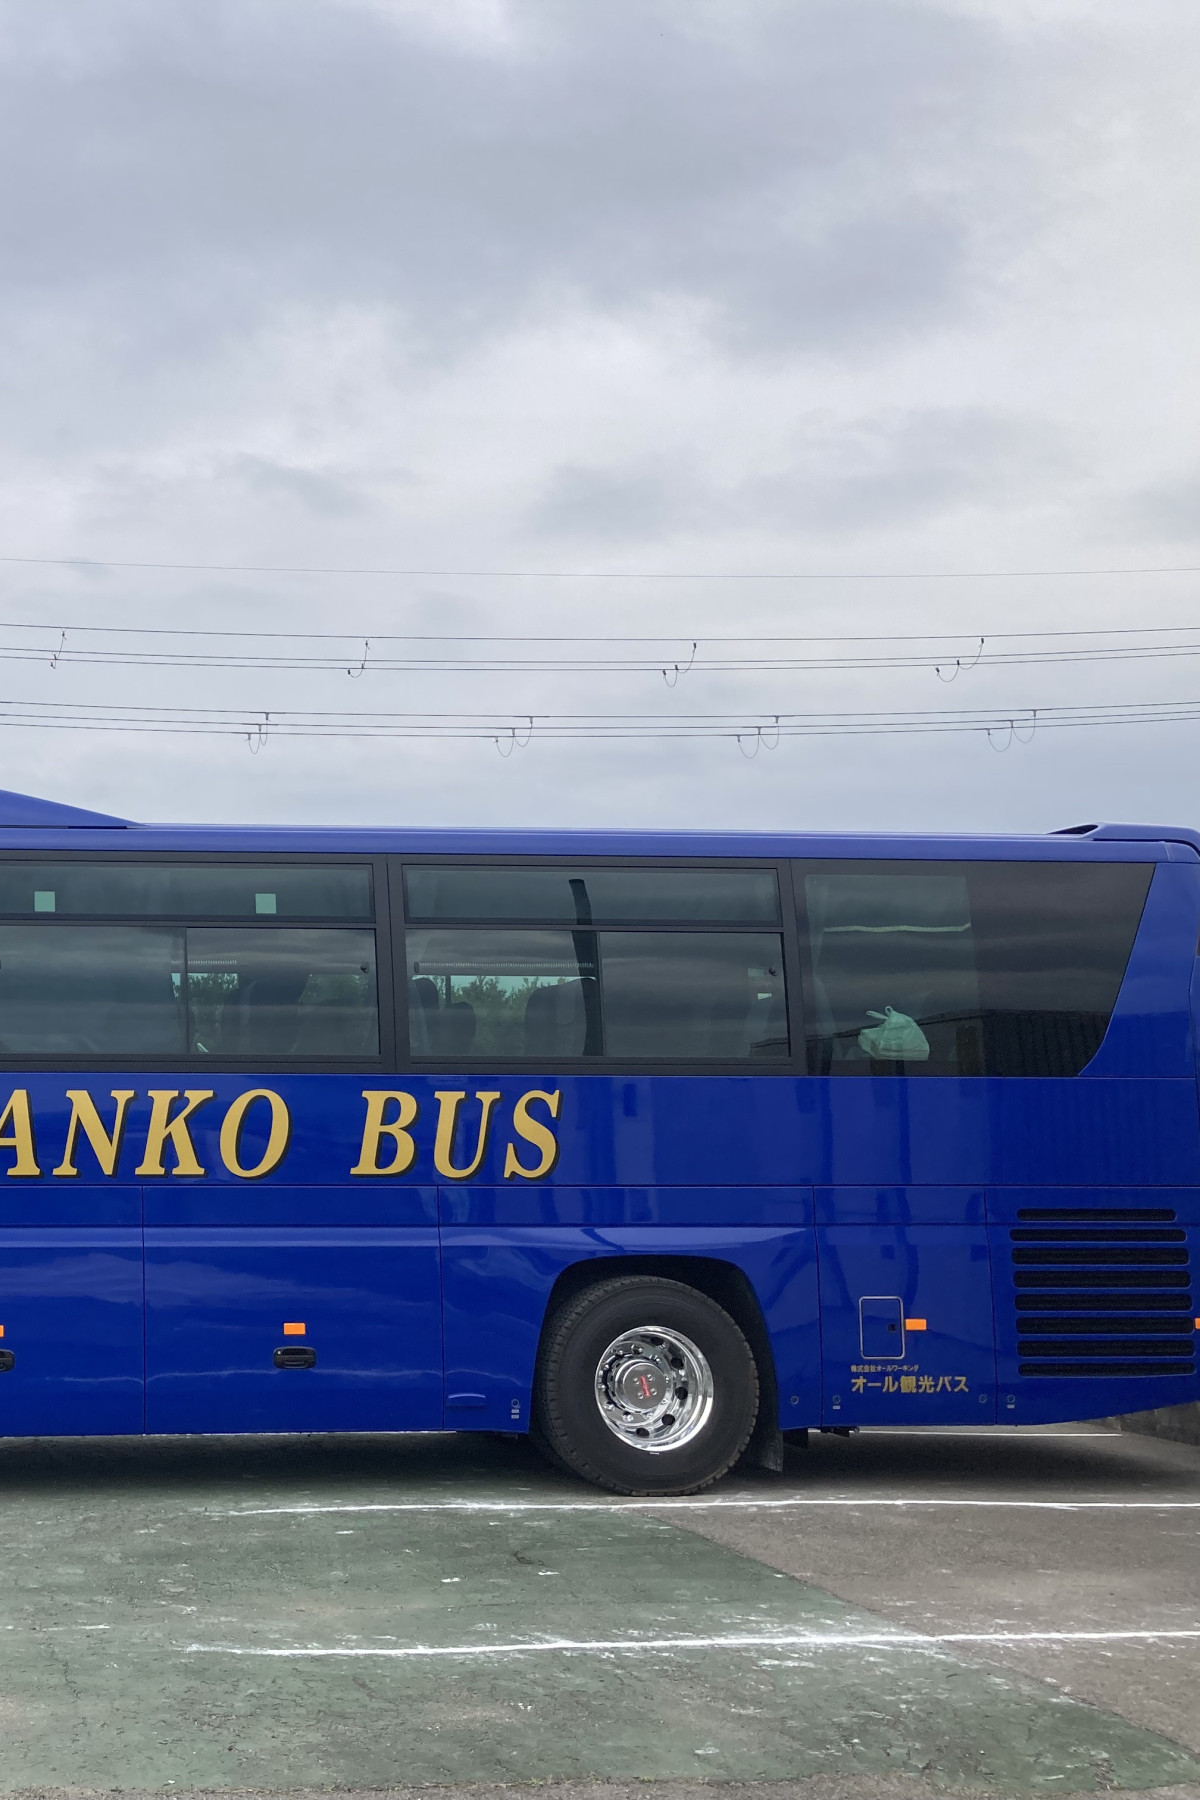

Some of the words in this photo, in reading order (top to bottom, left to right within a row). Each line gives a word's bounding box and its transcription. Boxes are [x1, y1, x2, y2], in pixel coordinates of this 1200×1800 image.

[351, 1091, 559, 1177] BUS
[852, 1375, 968, 1393] オール観光バス
